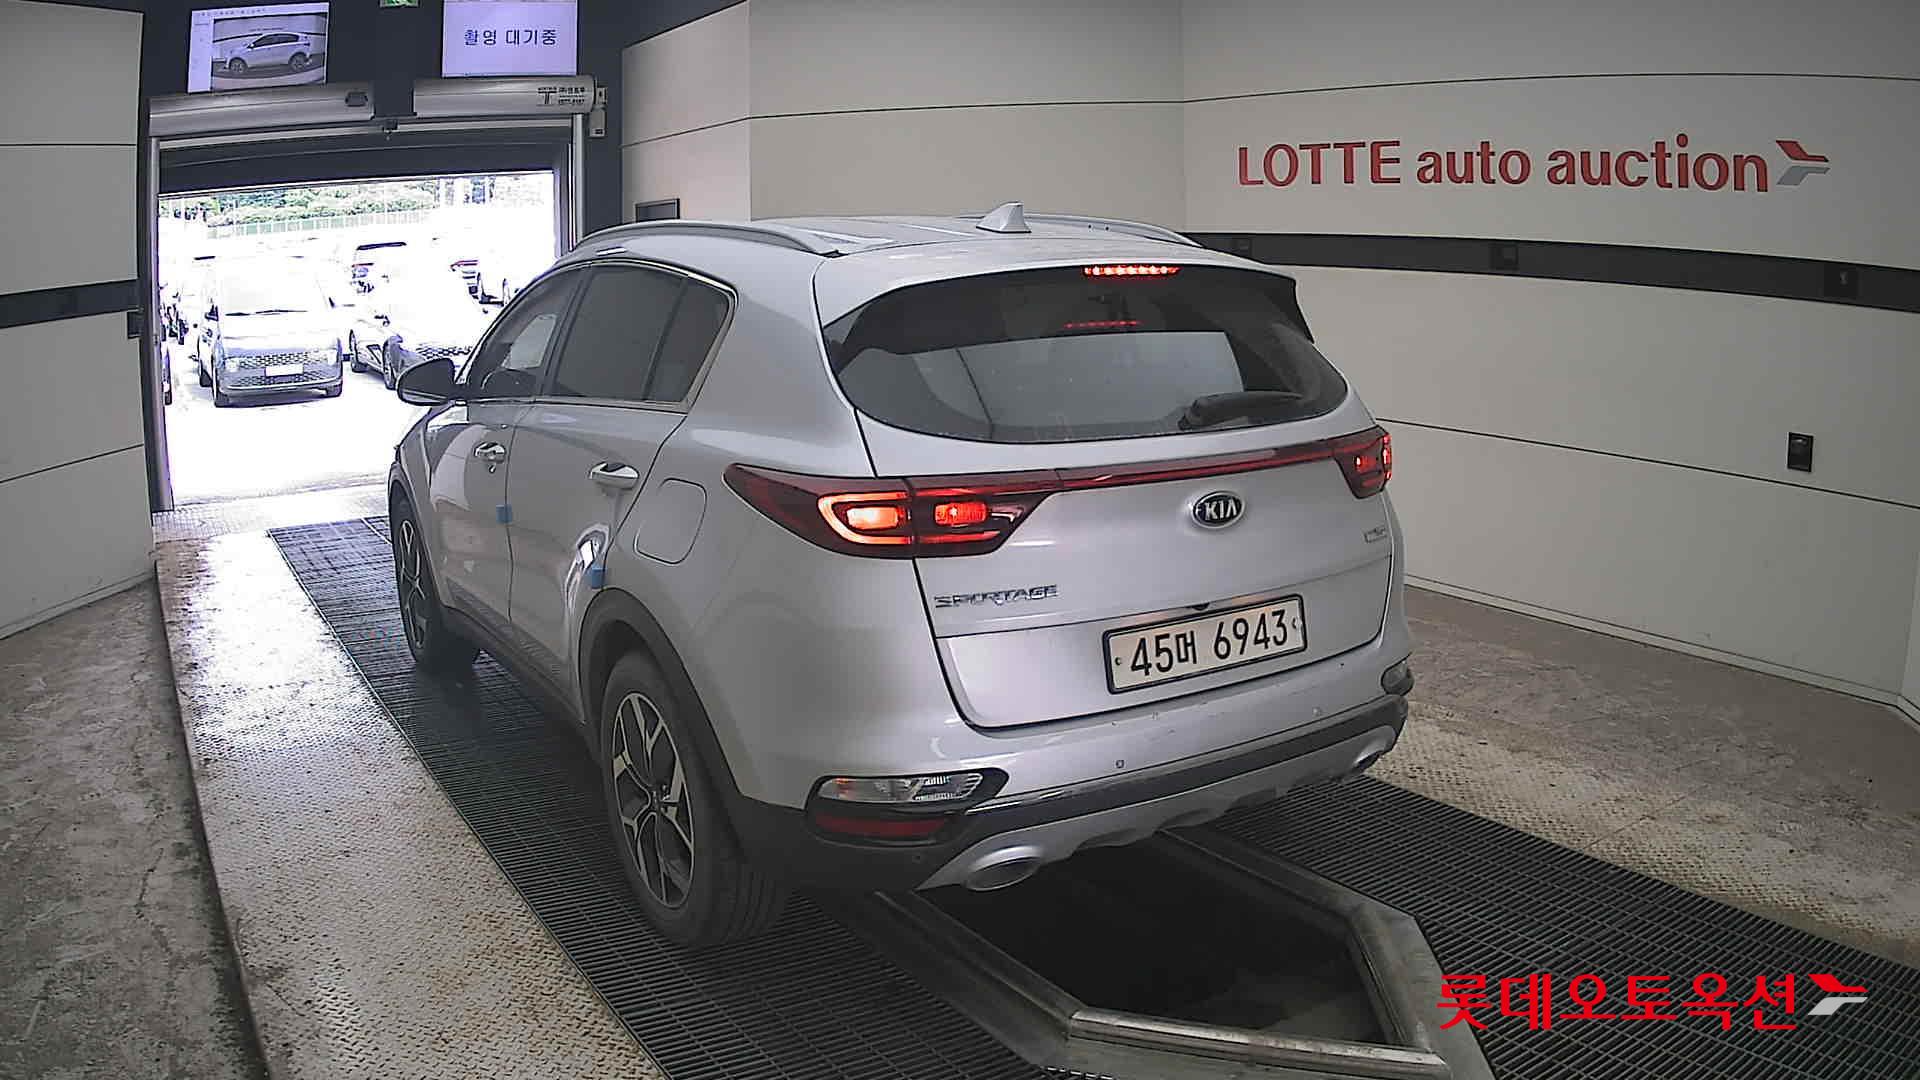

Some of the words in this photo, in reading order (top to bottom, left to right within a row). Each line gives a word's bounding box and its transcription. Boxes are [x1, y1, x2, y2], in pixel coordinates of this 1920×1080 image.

[464, 29, 497, 46] 촬영
[505, 29, 558, 46] 대기중
[1238, 140, 1400, 186] LOTTE
[1416, 140, 1531, 185] auto
[1547, 133, 1769, 193] auction
[1205, 499, 1238, 520] KIA
[934, 584, 1058, 608] SPORTAGE
[1130, 630, 1198, 677] 45머
[1213, 608, 1289, 661] 6943
